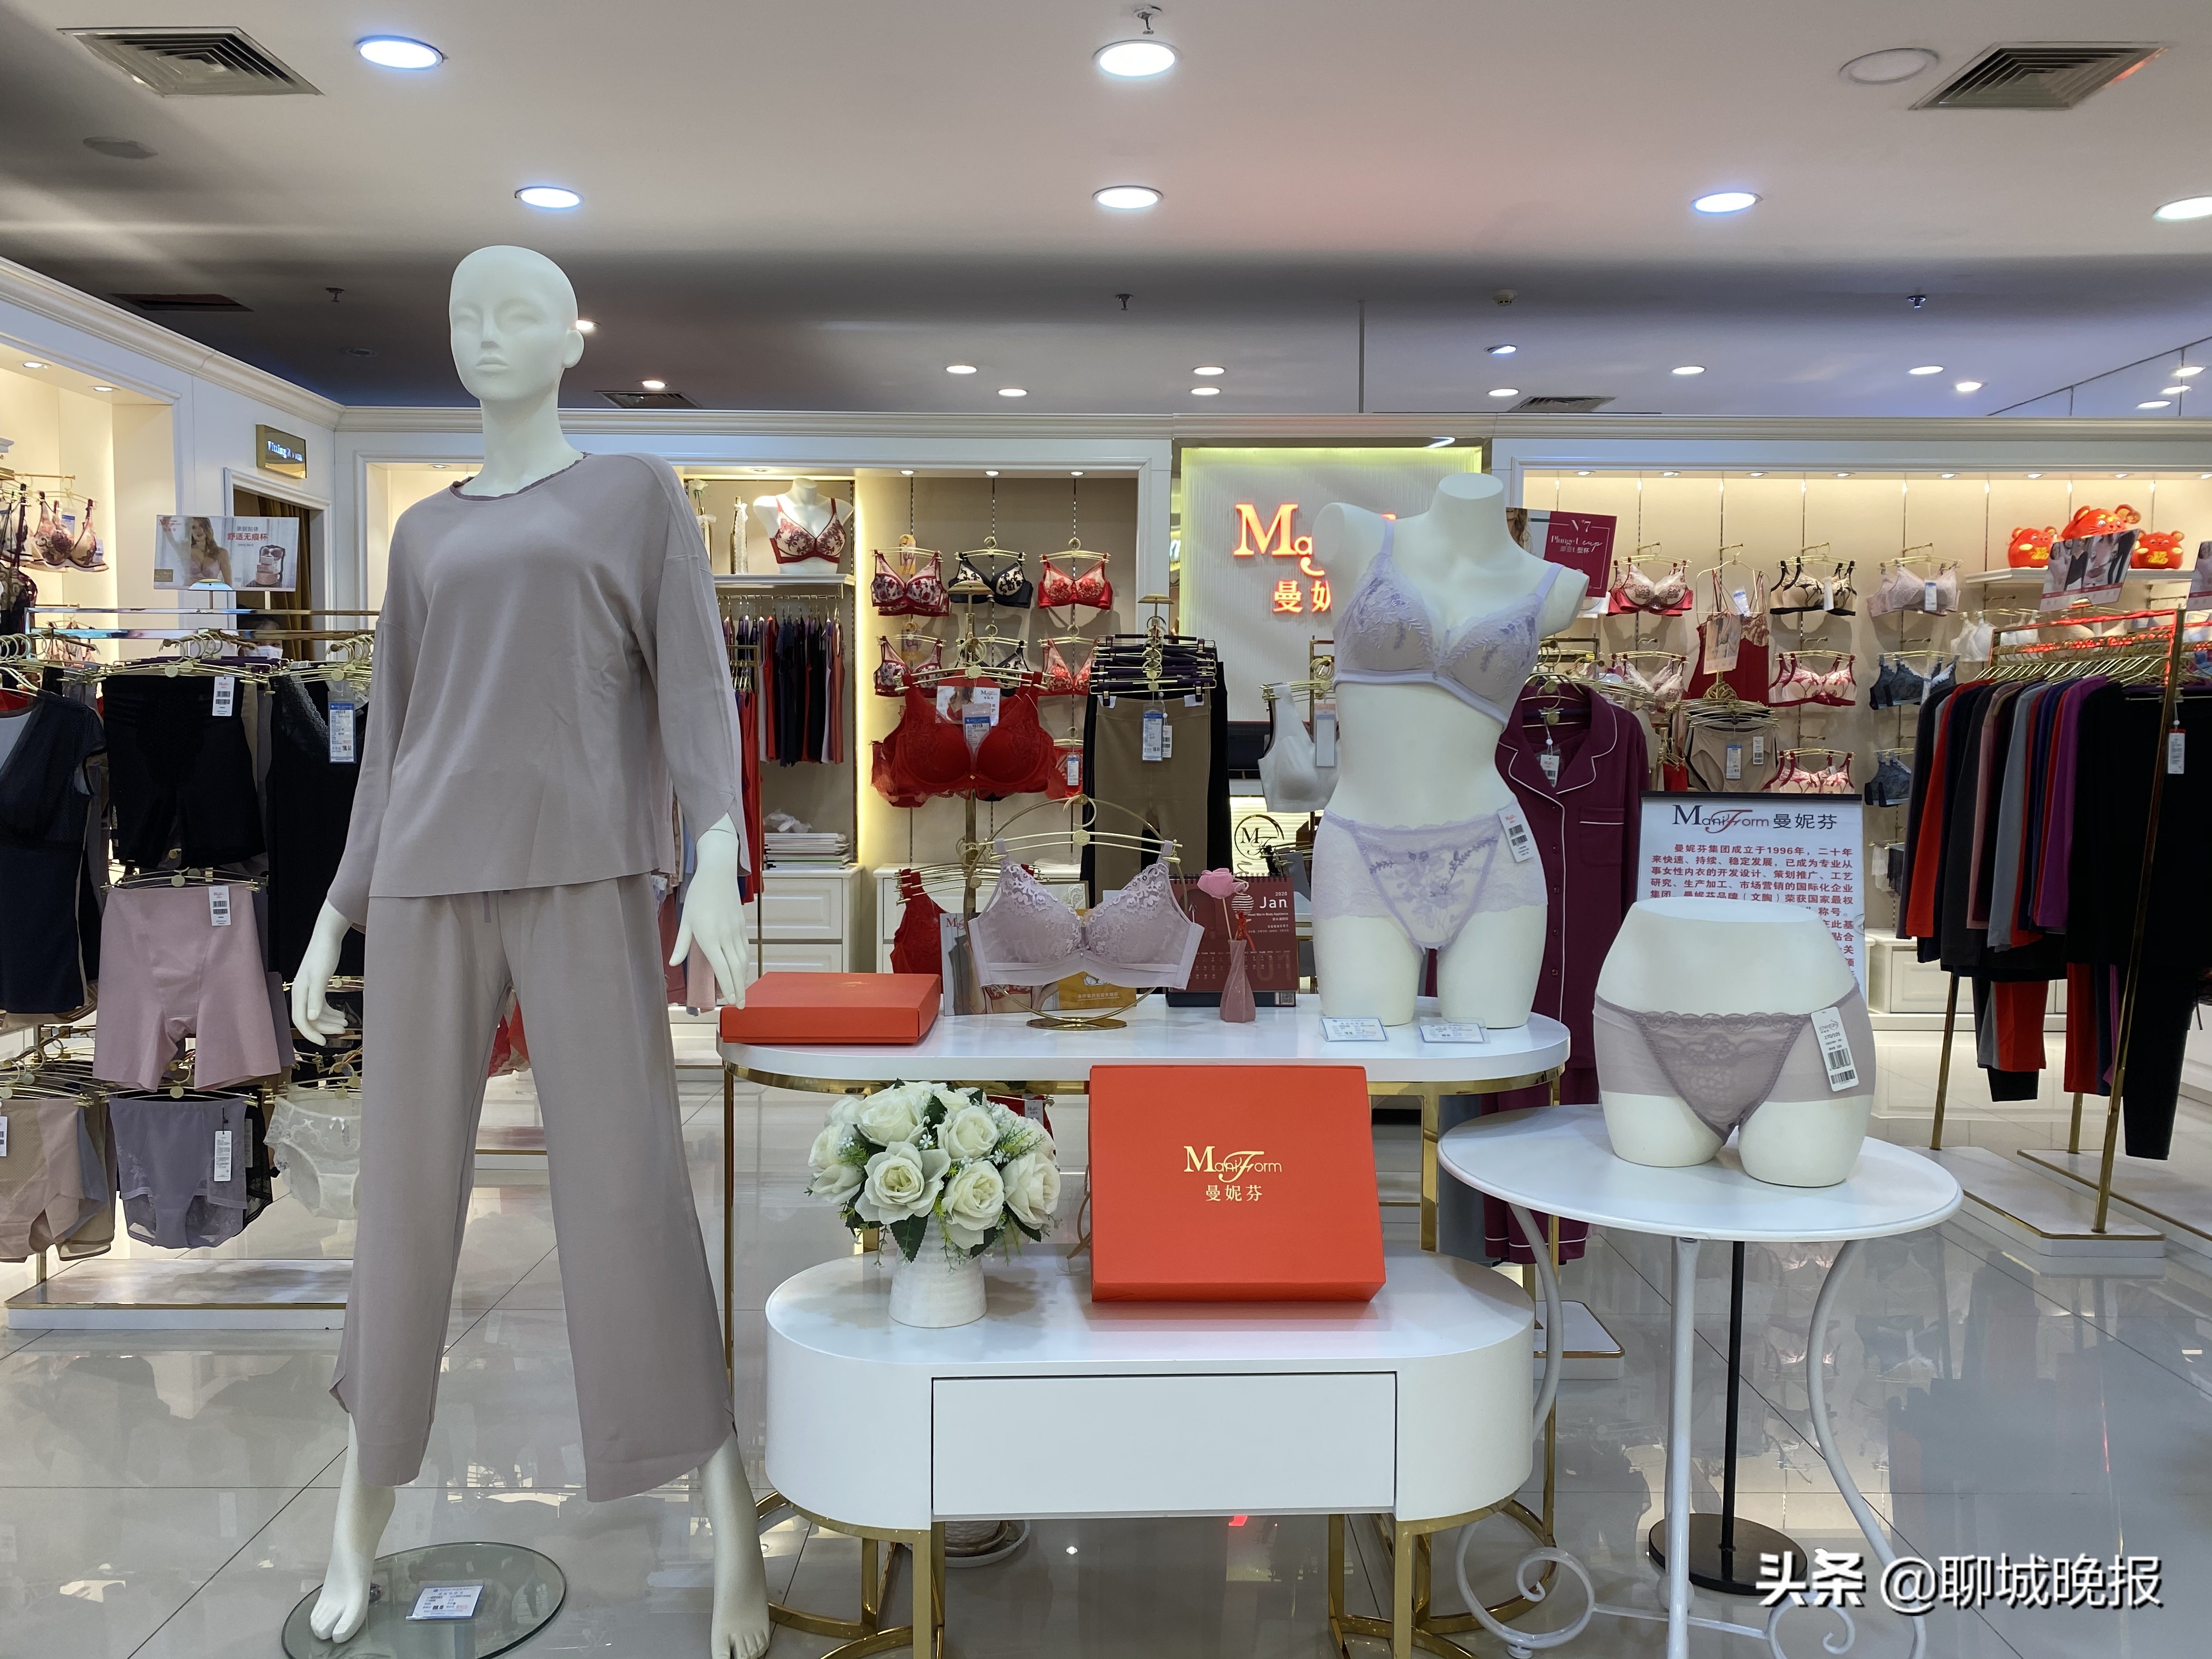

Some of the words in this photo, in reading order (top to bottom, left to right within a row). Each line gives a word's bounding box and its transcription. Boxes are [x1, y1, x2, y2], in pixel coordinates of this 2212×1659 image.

[227, 532, 268, 541] 舒适无痕杯
[1672, 804, 1769, 833] ManiForm
[1773, 813, 1837, 830] 曼妮芬
[1674, 844, 1853, 856] 曼妮芬集团成立于1996年，二十年
[1652, 855, 1853, 868] 来快速、持续、稳定发展，已成为专业从
[1651, 866, 1853, 881] 事女性内衣的开发设计、策划推广、工艺
[1650, 878, 1853, 893] 研究、生产加工、市场营销的国际化企业
[1650, 890, 1853, 905] 集团曼妮芬品牌（文胸）荣获国家最权
[1184, 1146, 1283, 1183] ManiForm
[1205, 1184, 1263, 1202] 曼妮芬
